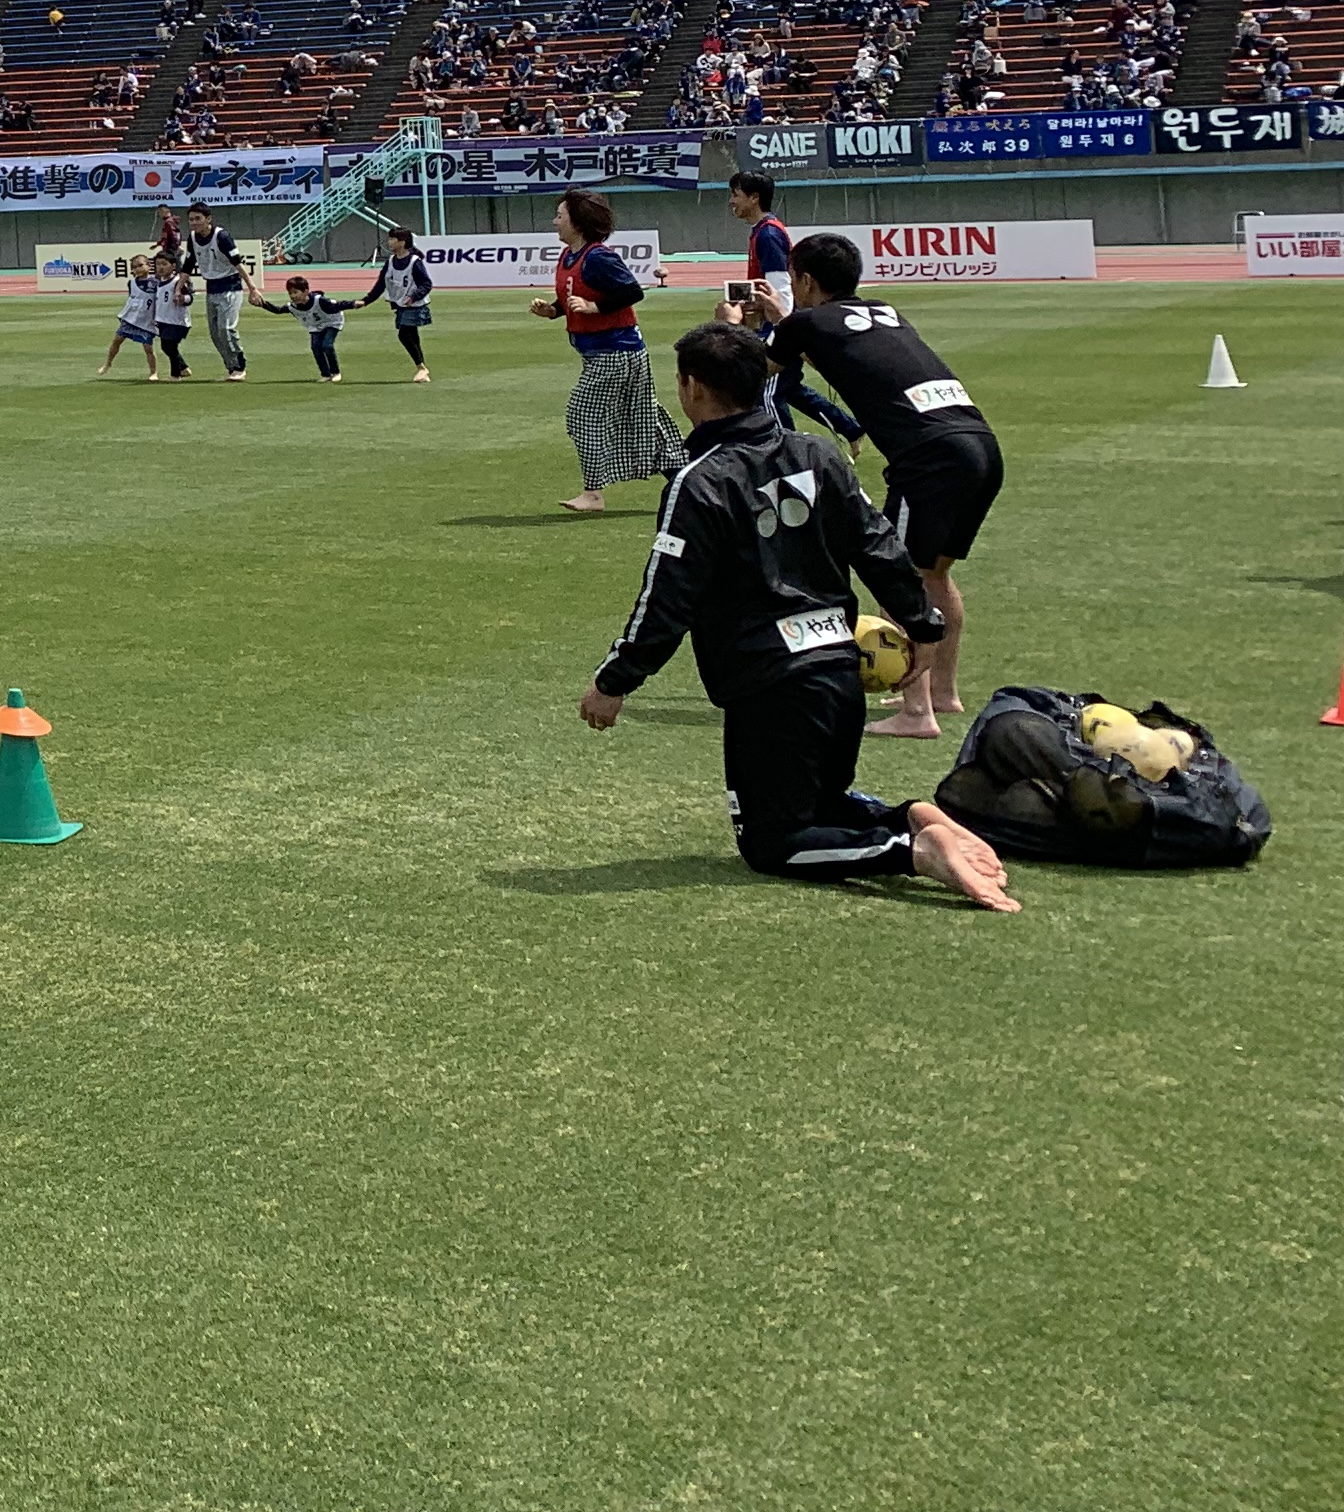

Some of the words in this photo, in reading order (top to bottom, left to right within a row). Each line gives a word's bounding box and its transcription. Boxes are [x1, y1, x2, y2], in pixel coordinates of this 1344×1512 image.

[1162, 107, 1292, 152] 원두재
[749, 131, 818, 160] SANE
[834, 125, 912, 156] KOKI
[938, 139, 997, 155] 弘次郎
[1003, 139, 1030, 152] 39
[1123, 133, 1134, 145] 6
[0, 164, 124, 201] 進撃の
[175, 156, 319, 196] ケネディ
[872, 226, 997, 257] KIRIN
[1256, 240, 1344, 258] いい部屋
[72, 263, 99, 276] NEXT
[875, 262, 997, 277] キリンビバレッジ
[403, 275, 409, 287] 6
